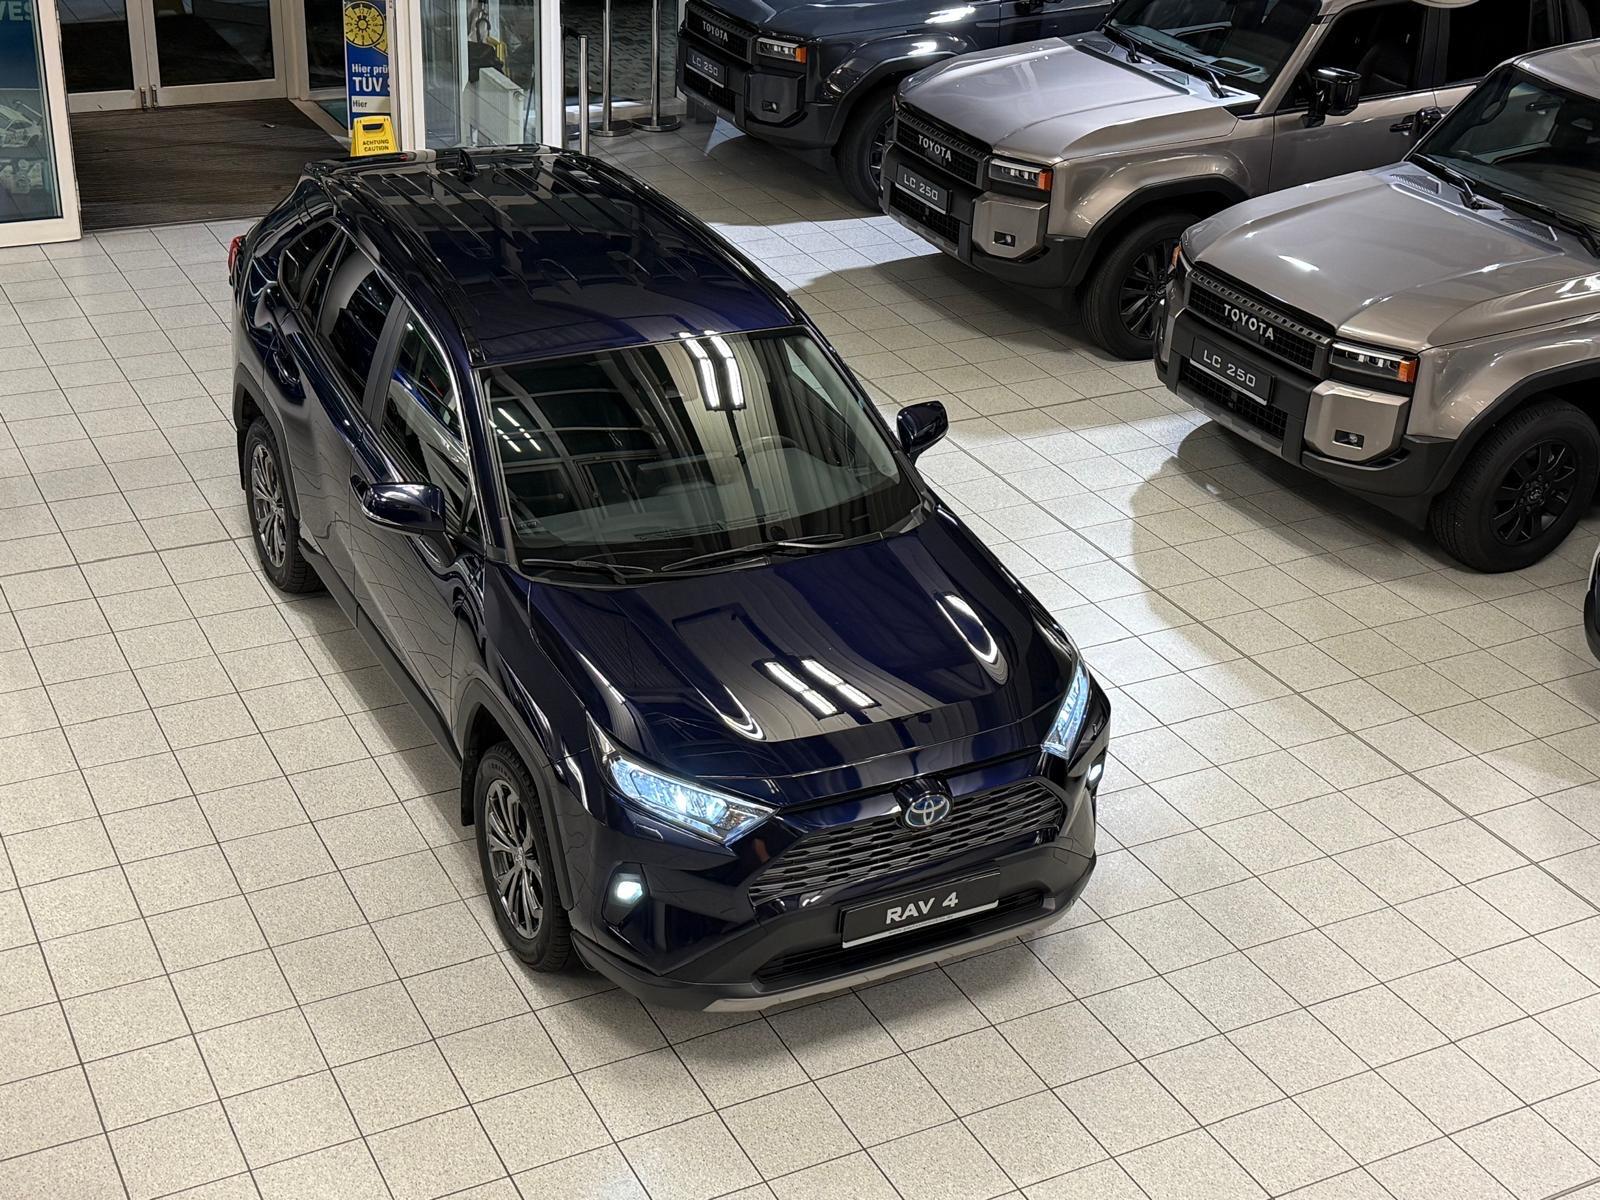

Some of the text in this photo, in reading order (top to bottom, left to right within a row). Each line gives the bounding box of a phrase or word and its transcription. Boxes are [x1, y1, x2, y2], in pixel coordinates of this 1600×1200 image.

[702, 20, 729, 42] TOYOTA
[351, 63, 371, 73] Hier
[692, 55, 719, 77] LC 250
[352, 73, 383, 92] TÜV
[352, 99, 368, 108] Hier
[362, 138, 390, 146] ACHTUNG
[918, 134, 952, 162] TOYOTA
[904, 173, 939, 201] LC 250
[1223, 303, 1274, 341] TOYOTA
[1203, 349, 1256, 388] LC 250
[886, 897, 936, 925] RAV
[942, 891, 959, 908] 4
